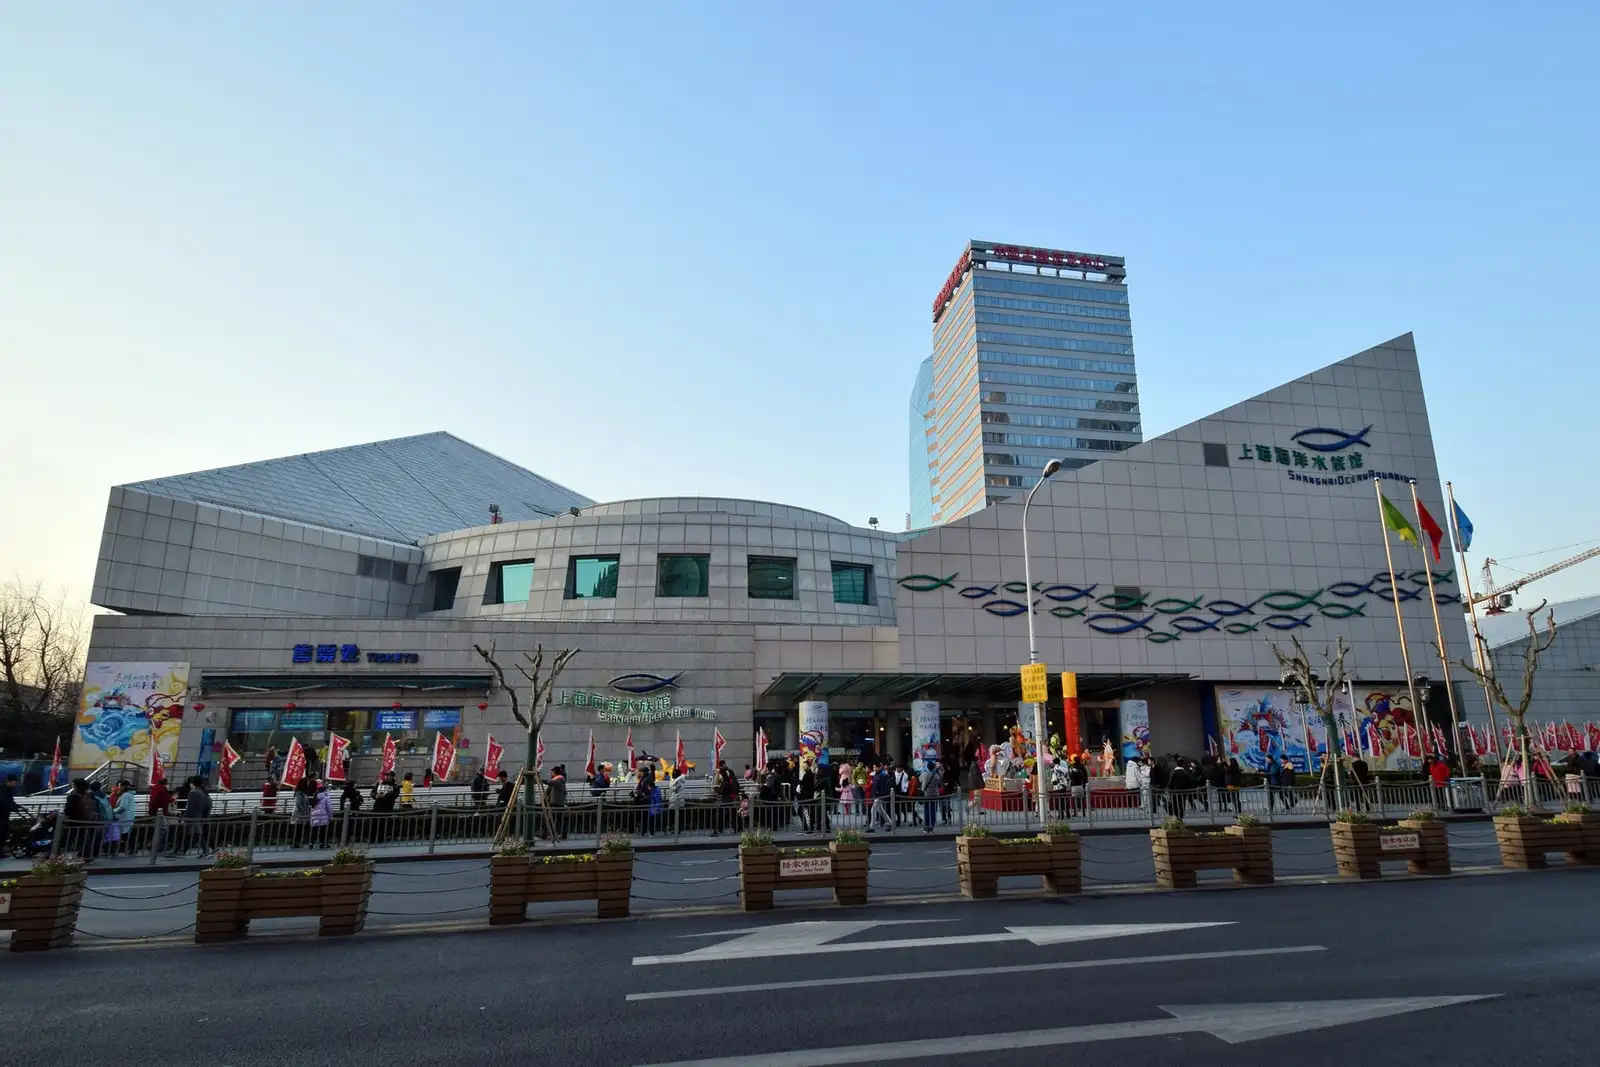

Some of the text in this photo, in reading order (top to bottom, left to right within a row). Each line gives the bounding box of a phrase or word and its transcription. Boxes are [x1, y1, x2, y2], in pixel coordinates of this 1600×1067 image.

[1238, 443, 1364, 472] 上海海洋水族馆
[292, 643, 361, 664] 售票处
[556, 689, 671, 713] 上海海洋水族馆
